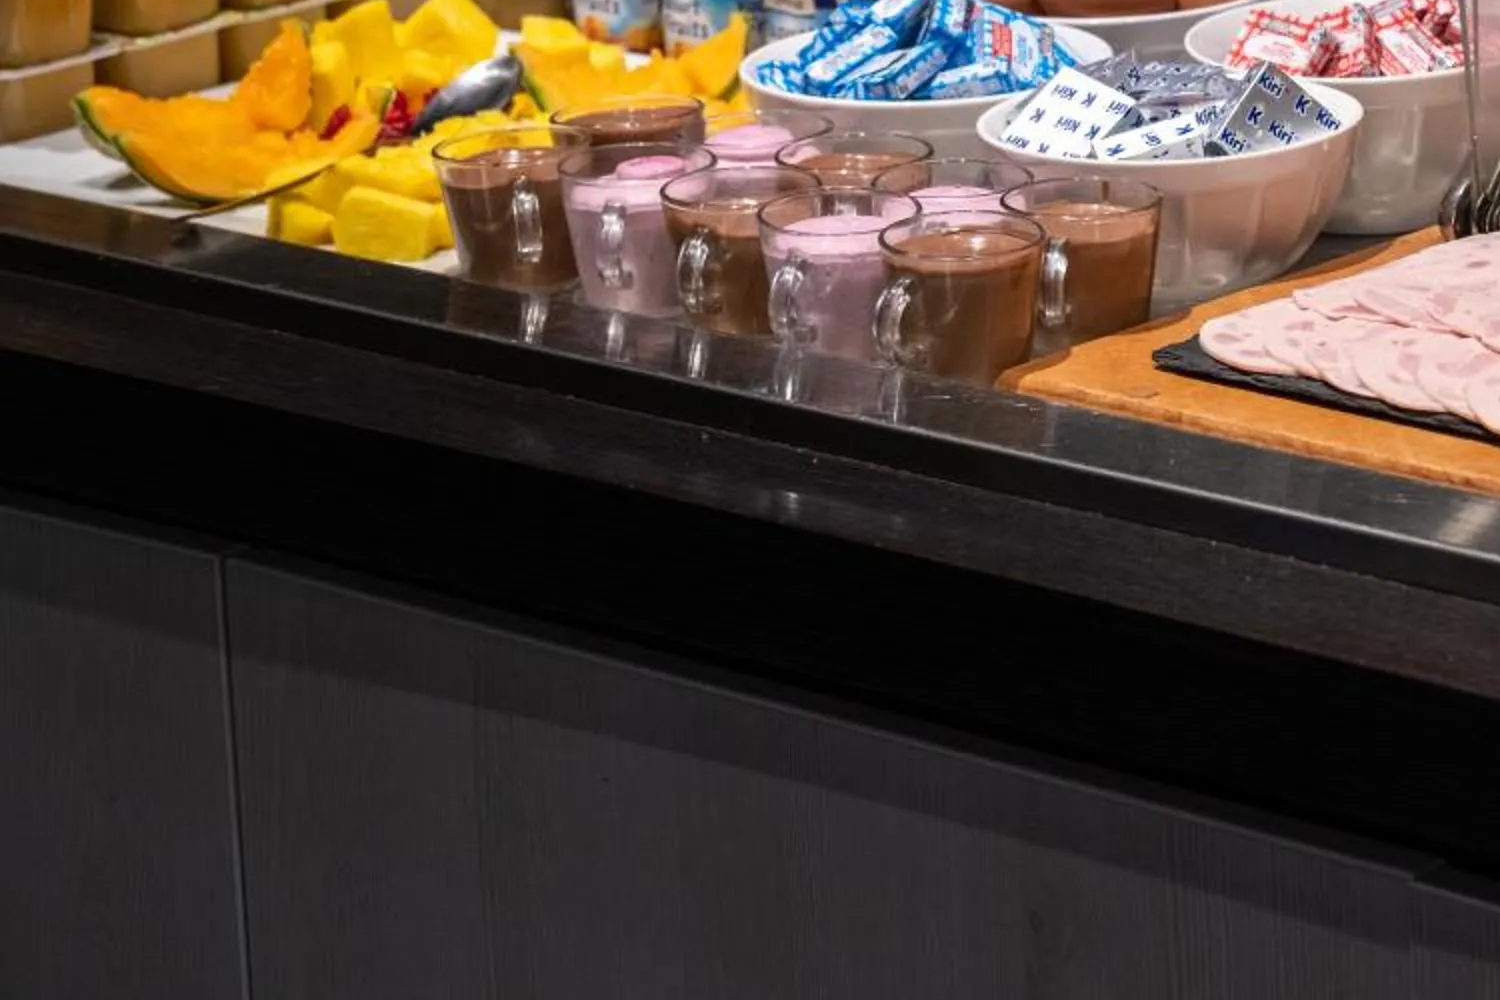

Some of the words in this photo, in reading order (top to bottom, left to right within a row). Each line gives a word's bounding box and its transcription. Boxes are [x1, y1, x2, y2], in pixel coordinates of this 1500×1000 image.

[1258, 71, 1284, 97] Kiri
[1295, 94, 1310, 115] K
[1316, 107, 1340, 131] Kiri
[1221, 127, 1247, 153] Kiri
[1247, 105, 1262, 125] K
[1268, 120, 1295, 145] Kiri
